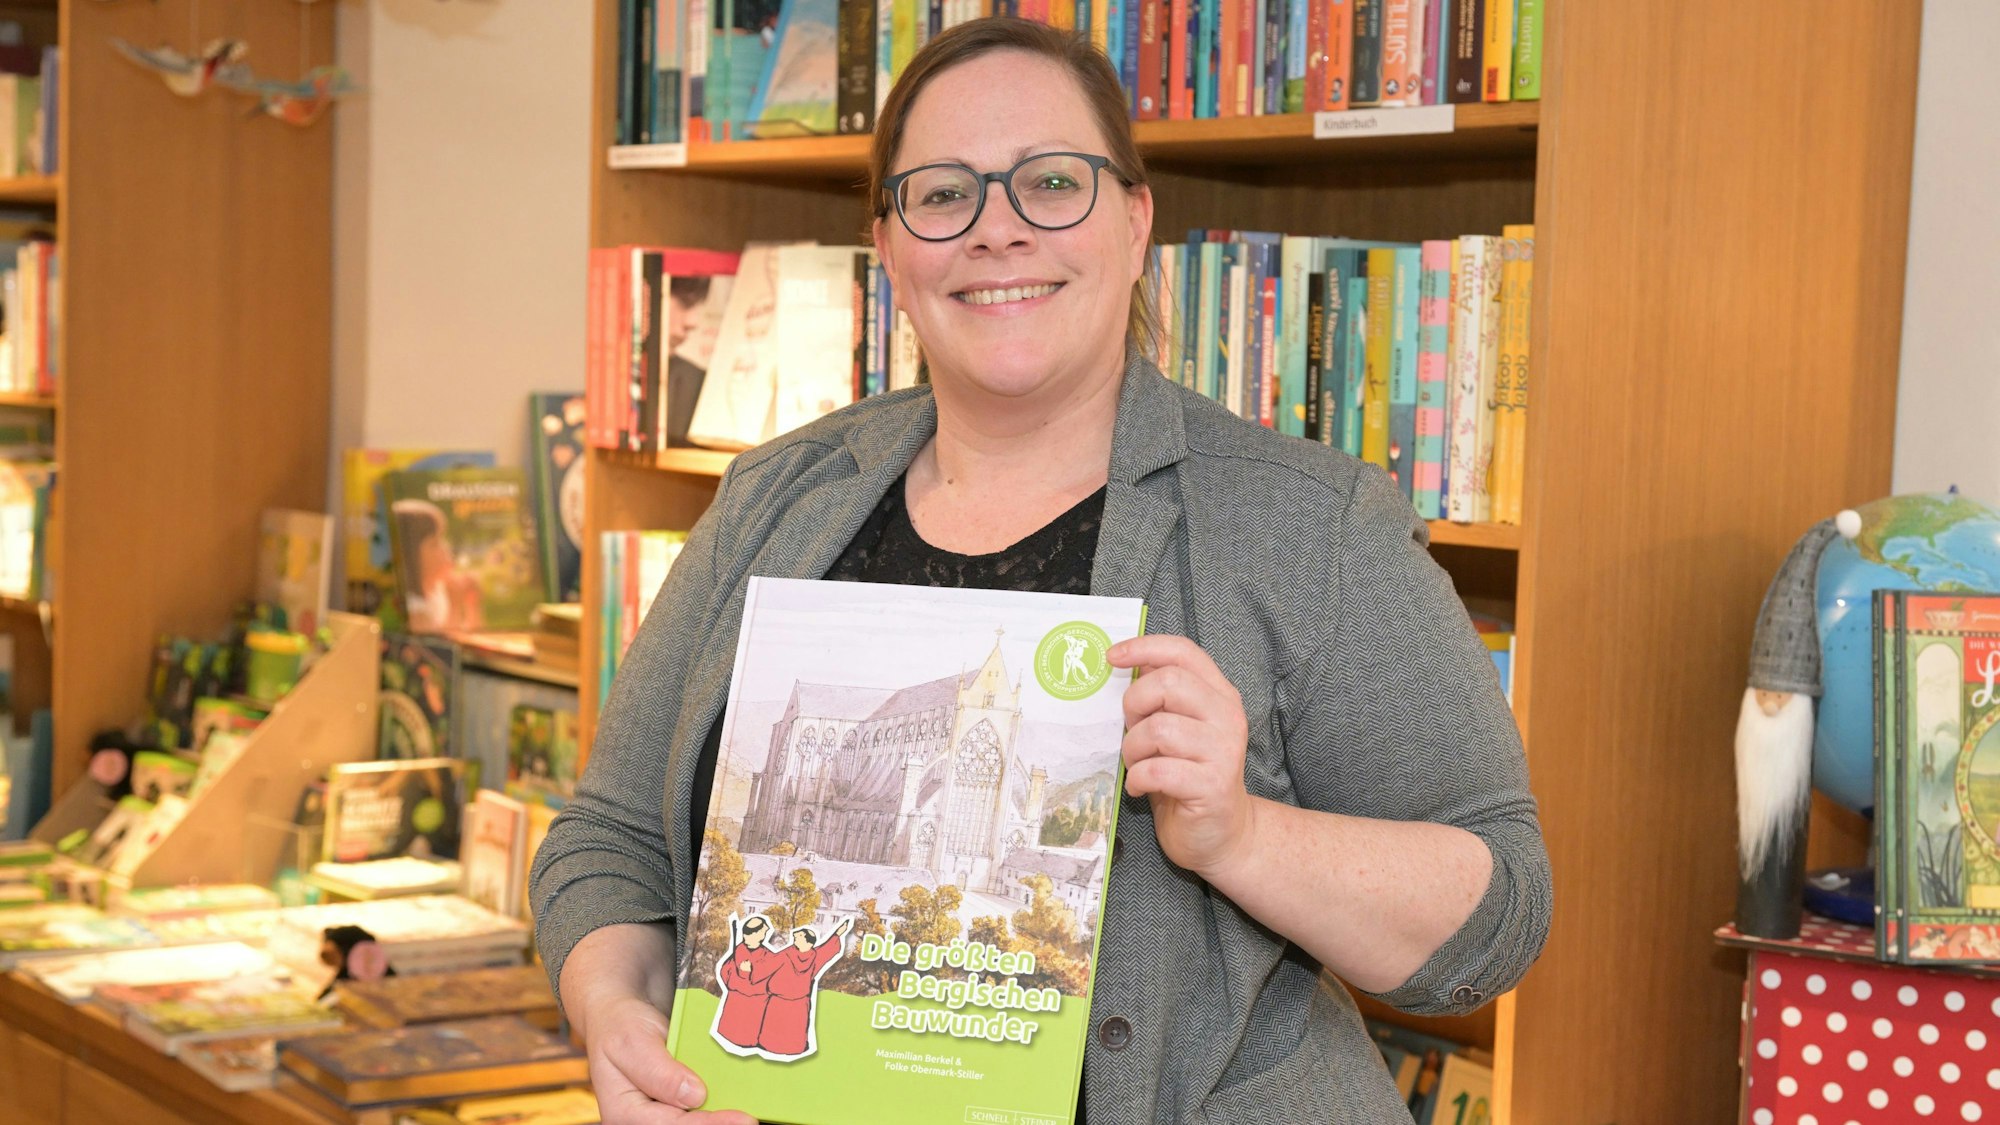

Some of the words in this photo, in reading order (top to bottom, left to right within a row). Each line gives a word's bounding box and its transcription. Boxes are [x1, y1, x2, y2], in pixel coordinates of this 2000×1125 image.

[1324, 115, 1378, 130] Kinderbuch
[1460, 253, 1476, 314] Anni
[861, 933, 911, 964] Die
[914, 938, 1036, 975] größten
[898, 970, 1062, 1013] Bergischen
[871, 1001, 1039, 1045] Bauwunder
[876, 1049, 923, 1062] Maximilian
[925, 1054, 954, 1066] Berkel
[955, 1058, 962, 1066] &
[885, 1060, 909, 1073] Folke
[910, 1064, 984, 1080] Obermark-Stiller
[971, 1110, 1010, 1124] SCHNELL
